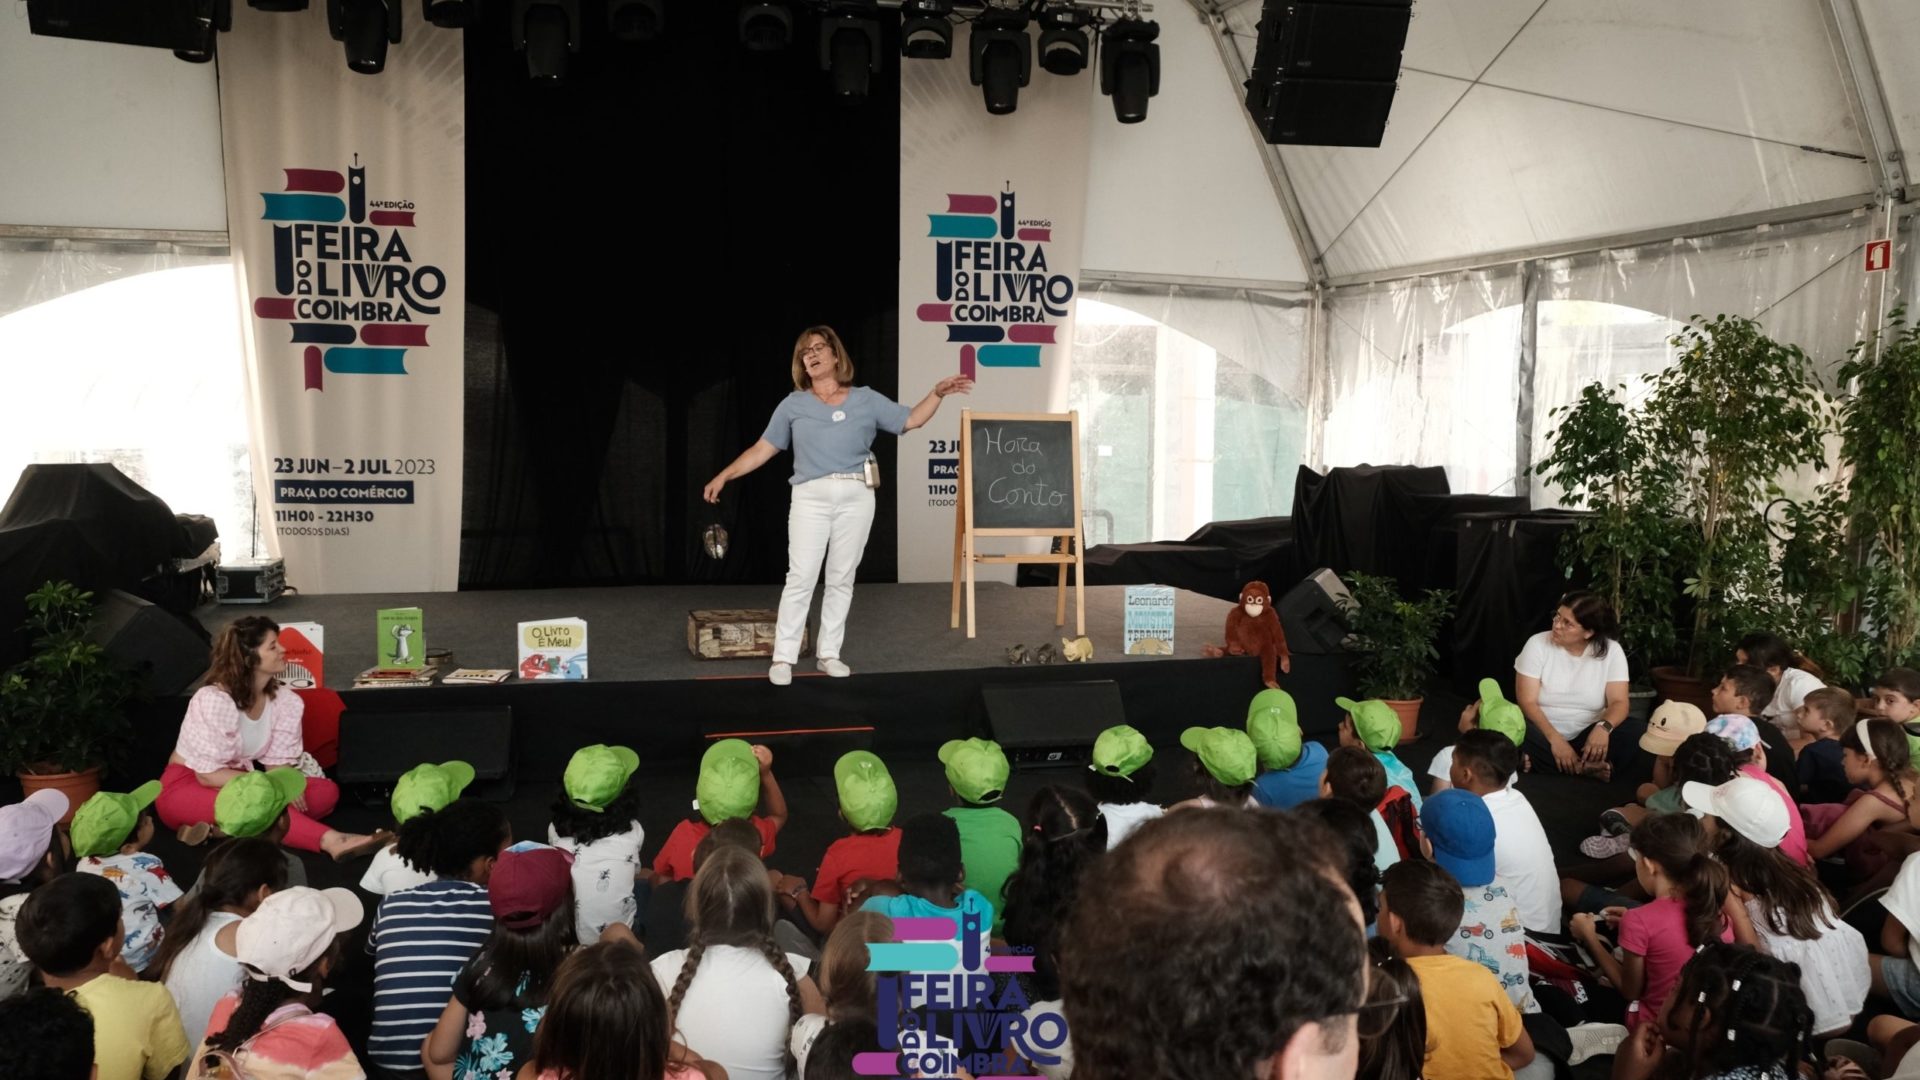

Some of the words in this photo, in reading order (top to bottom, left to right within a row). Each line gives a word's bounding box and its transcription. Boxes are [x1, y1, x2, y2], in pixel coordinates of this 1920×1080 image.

[294, 223, 412, 262] FEIRA
[954, 240, 1048, 272] FEIRA
[296, 259, 312, 295] DO
[955, 271, 970, 301] DO
[317, 261, 447, 314] LIVRO
[973, 272, 1074, 317] LIVRO
[297, 298, 412, 322] COIMBRA
[954, 304, 1046, 323] COIMBRA
[928, 440, 946, 453] 23
[984, 427, 1044, 457] Hora
[273, 457, 294, 473] 23
[297, 458, 330, 474] JUN
[344, 459, 355, 474] 2
[358, 459, 392, 475] JUL
[395, 459, 435, 475] 2023
[1012, 457, 1036, 475] do
[280, 487, 317, 500] PRAÇA
[319, 488, 338, 498] DO
[340, 485, 408, 498] COMÉRCIO
[928, 485, 957, 495] 11H0
[988, 476, 1068, 507] Conto
[928, 499, 957, 507] (TODO
[275, 510, 314, 522] 11H00
[326, 511, 374, 522] 22H30
[1128, 595, 1174, 606] Leonardo
[531, 627, 542, 639] O
[547, 637, 572, 647] Meu!
